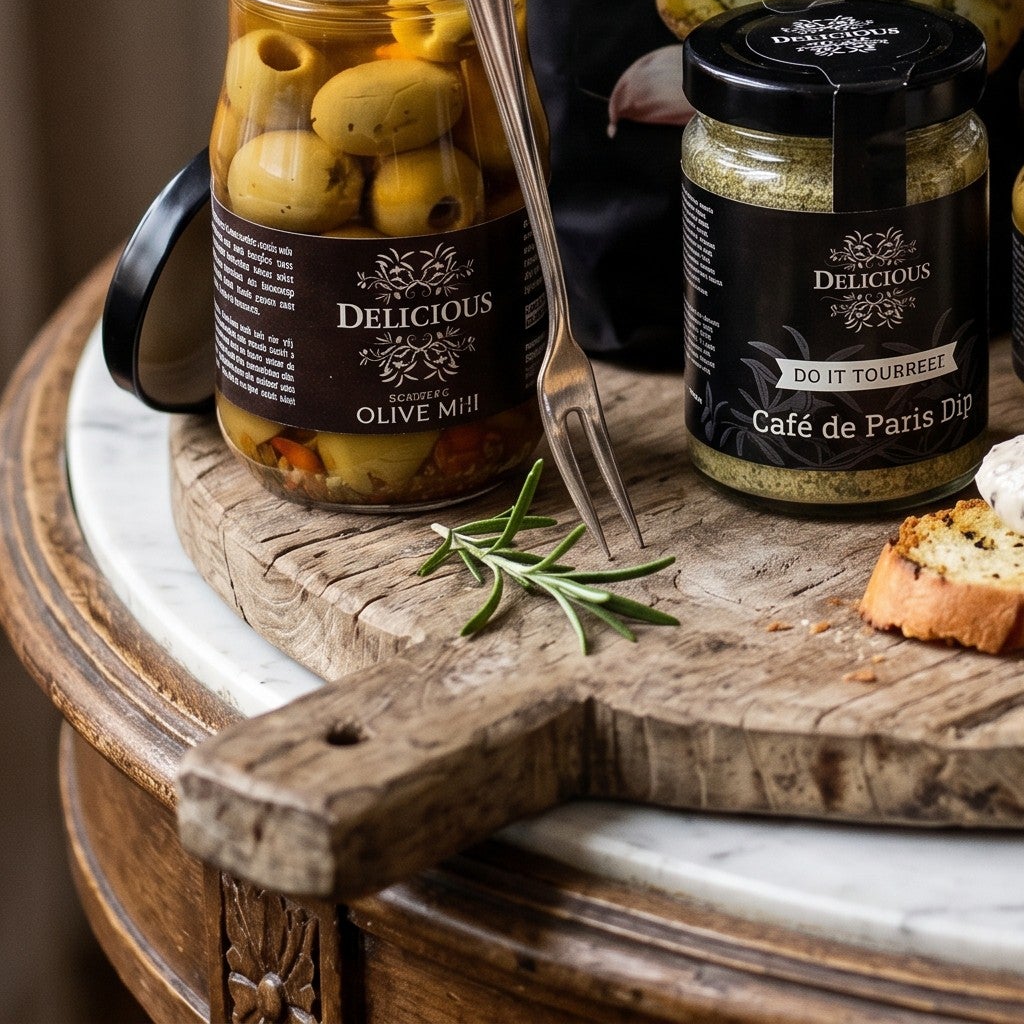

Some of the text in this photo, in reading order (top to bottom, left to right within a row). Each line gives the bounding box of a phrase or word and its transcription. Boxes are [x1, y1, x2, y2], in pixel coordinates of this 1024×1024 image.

[771, 27, 900, 44] DELICIOUS
[813, 262, 931, 290] DELICIOUS
[336, 291, 493, 329] DELICIOUS
[794, 368, 821, 384] DO
[828, 369, 846, 384] IT
[356, 403, 430, 424] OLIVE
[751, 393, 973, 439] Café de Paris Dip
